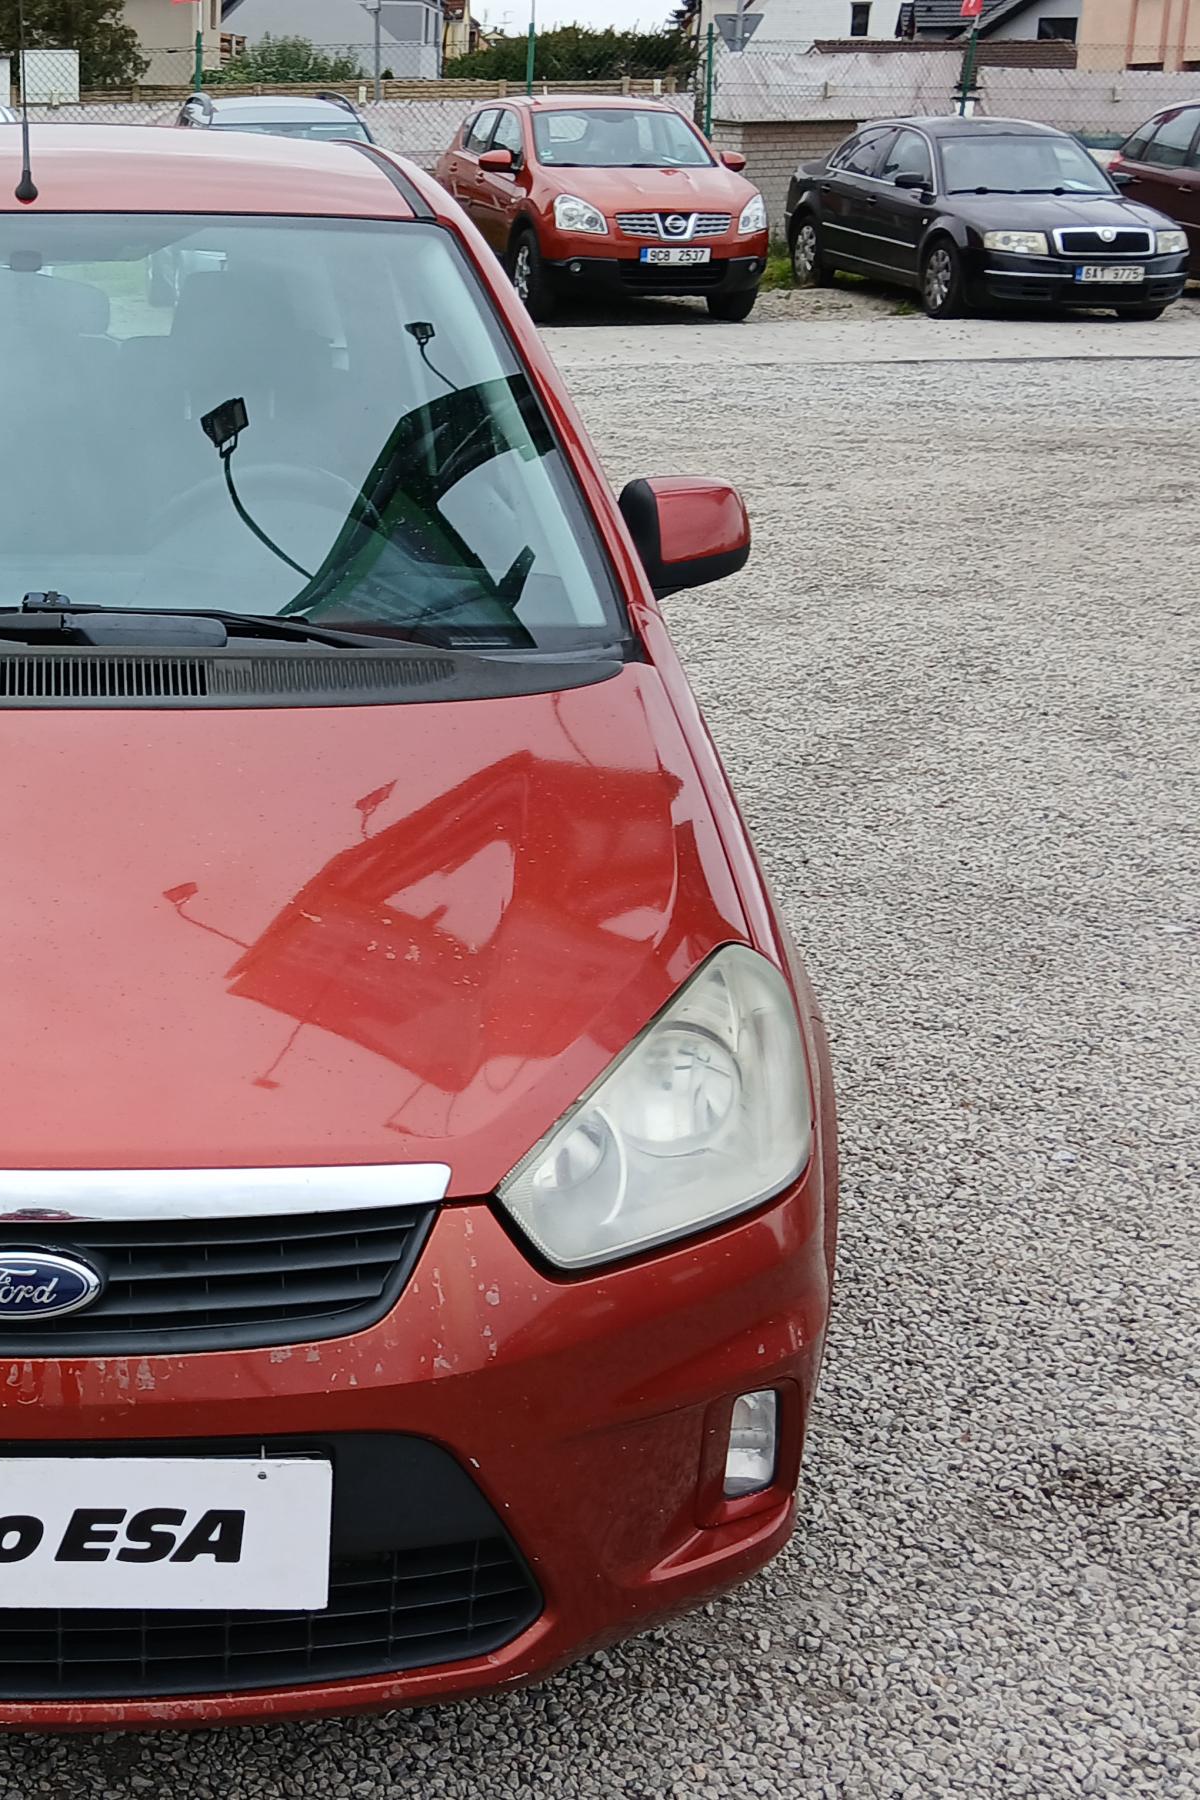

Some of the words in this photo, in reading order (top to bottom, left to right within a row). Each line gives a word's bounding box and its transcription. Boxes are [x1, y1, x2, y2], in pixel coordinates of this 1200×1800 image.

[650, 250, 670, 261] 9C8
[678, 250, 705, 261] 2537
[54, 1508, 246, 1564] ESA
